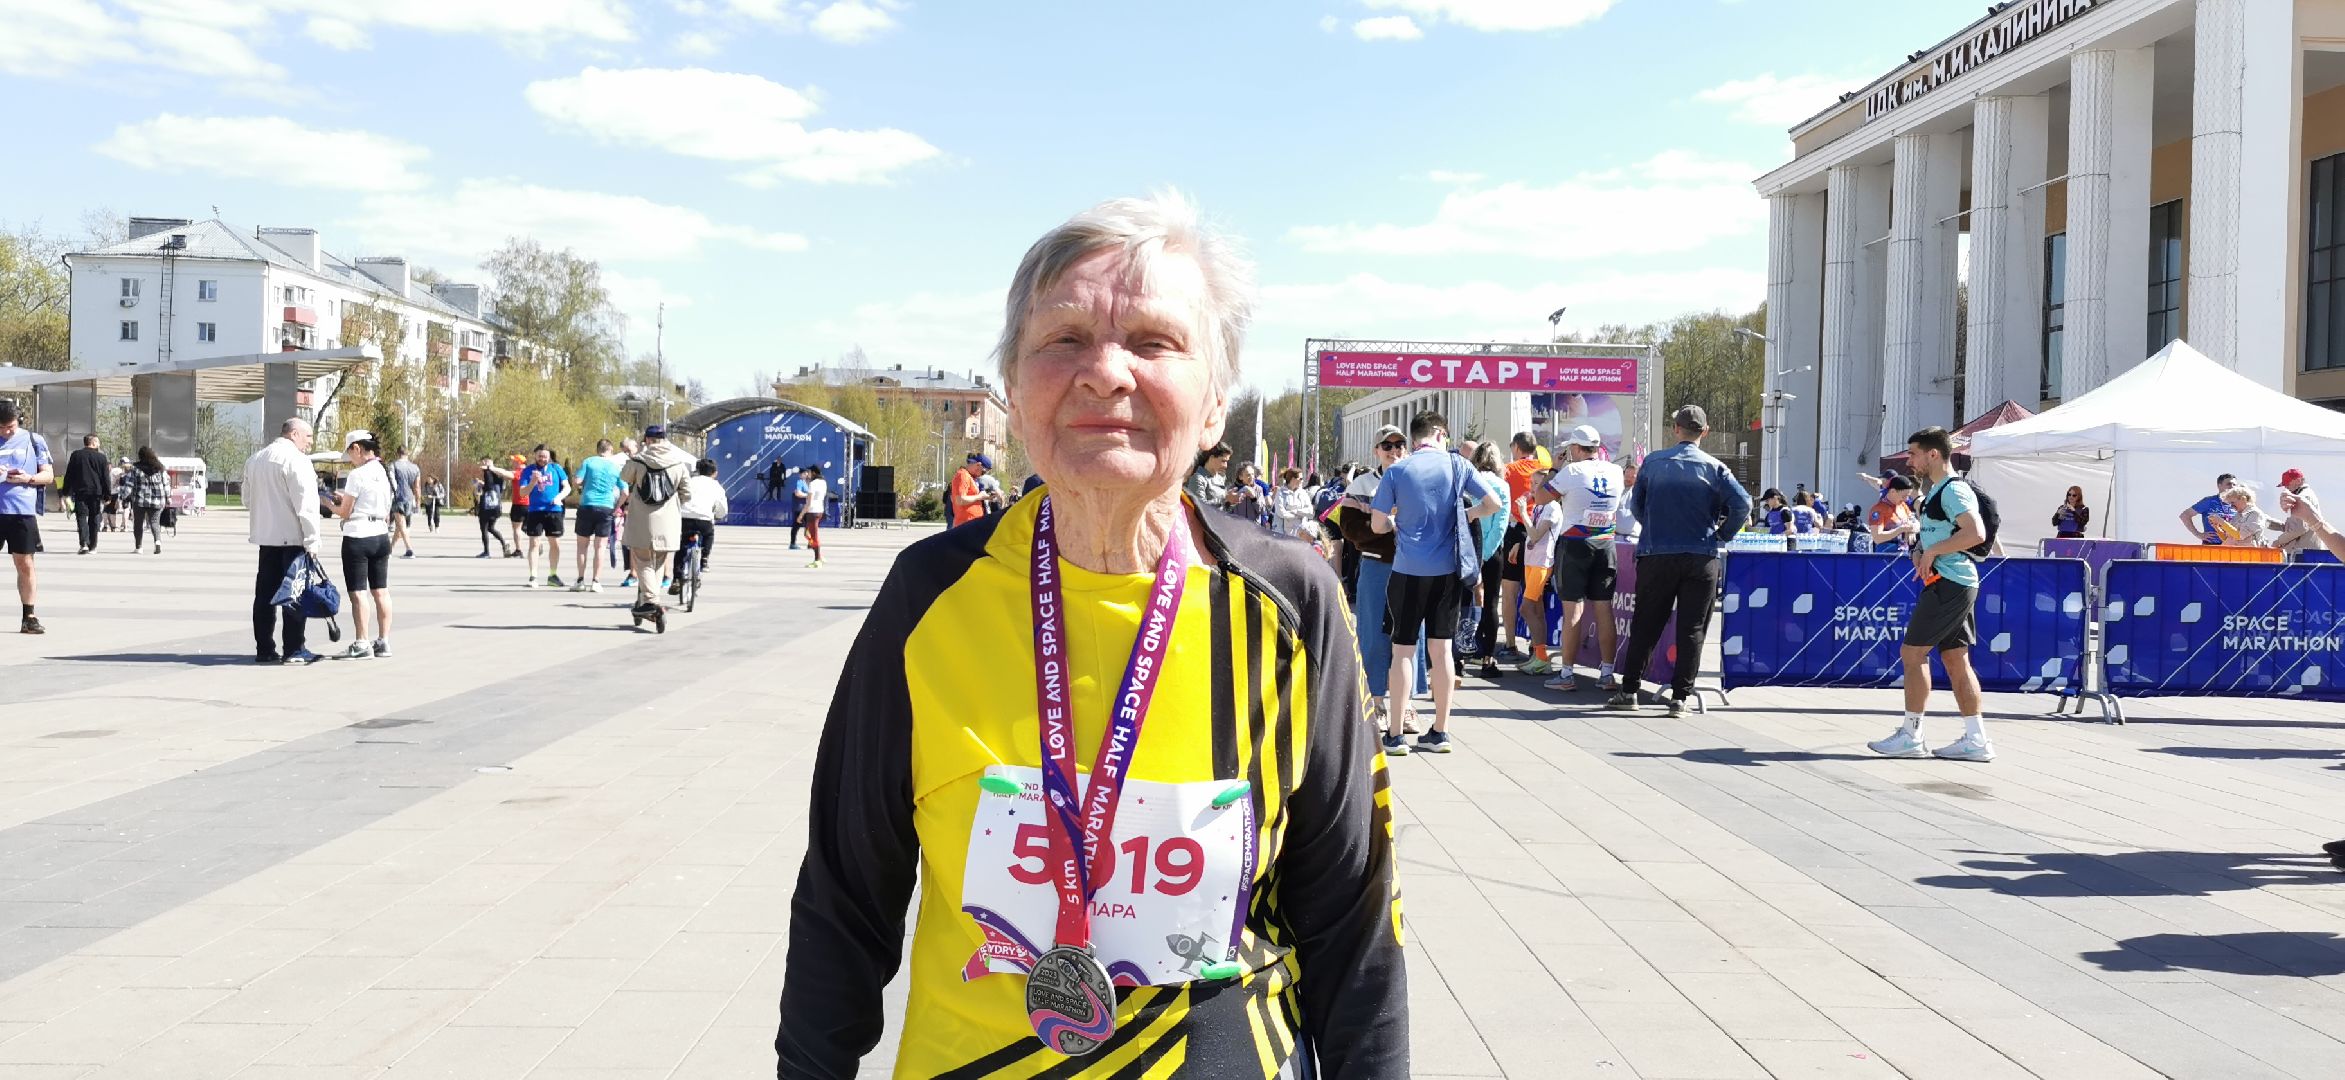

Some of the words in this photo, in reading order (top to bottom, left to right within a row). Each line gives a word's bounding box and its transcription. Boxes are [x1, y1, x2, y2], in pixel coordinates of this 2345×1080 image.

[1865, 81, 1899, 122] ЦДК
[1903, 75, 1928, 102] им.
[1410, 359, 1547, 385] СТАРТ
[764, 433, 812, 442] MARATHON
[1037, 539, 1052, 585] HALF
[1040, 591, 1058, 656] SPACE
[1834, 606, 1898, 622] SPACE
[2223, 615, 2288, 631] SPACE
[1143, 608, 1167, 652] AND
[1044, 661, 1062, 703] AND
[1120, 654, 1153, 721] SPACE
[1103, 725, 1131, 779] HALF
[1064, 859, 1078, 890] km
[1066, 896, 1080, 905] 5
[1040, 968, 1058, 980] 2023
[1032, 996, 1050, 1005] HALF
[1050, 994, 1064, 1002] AND
[1065, 998, 1088, 1009] SPACE
